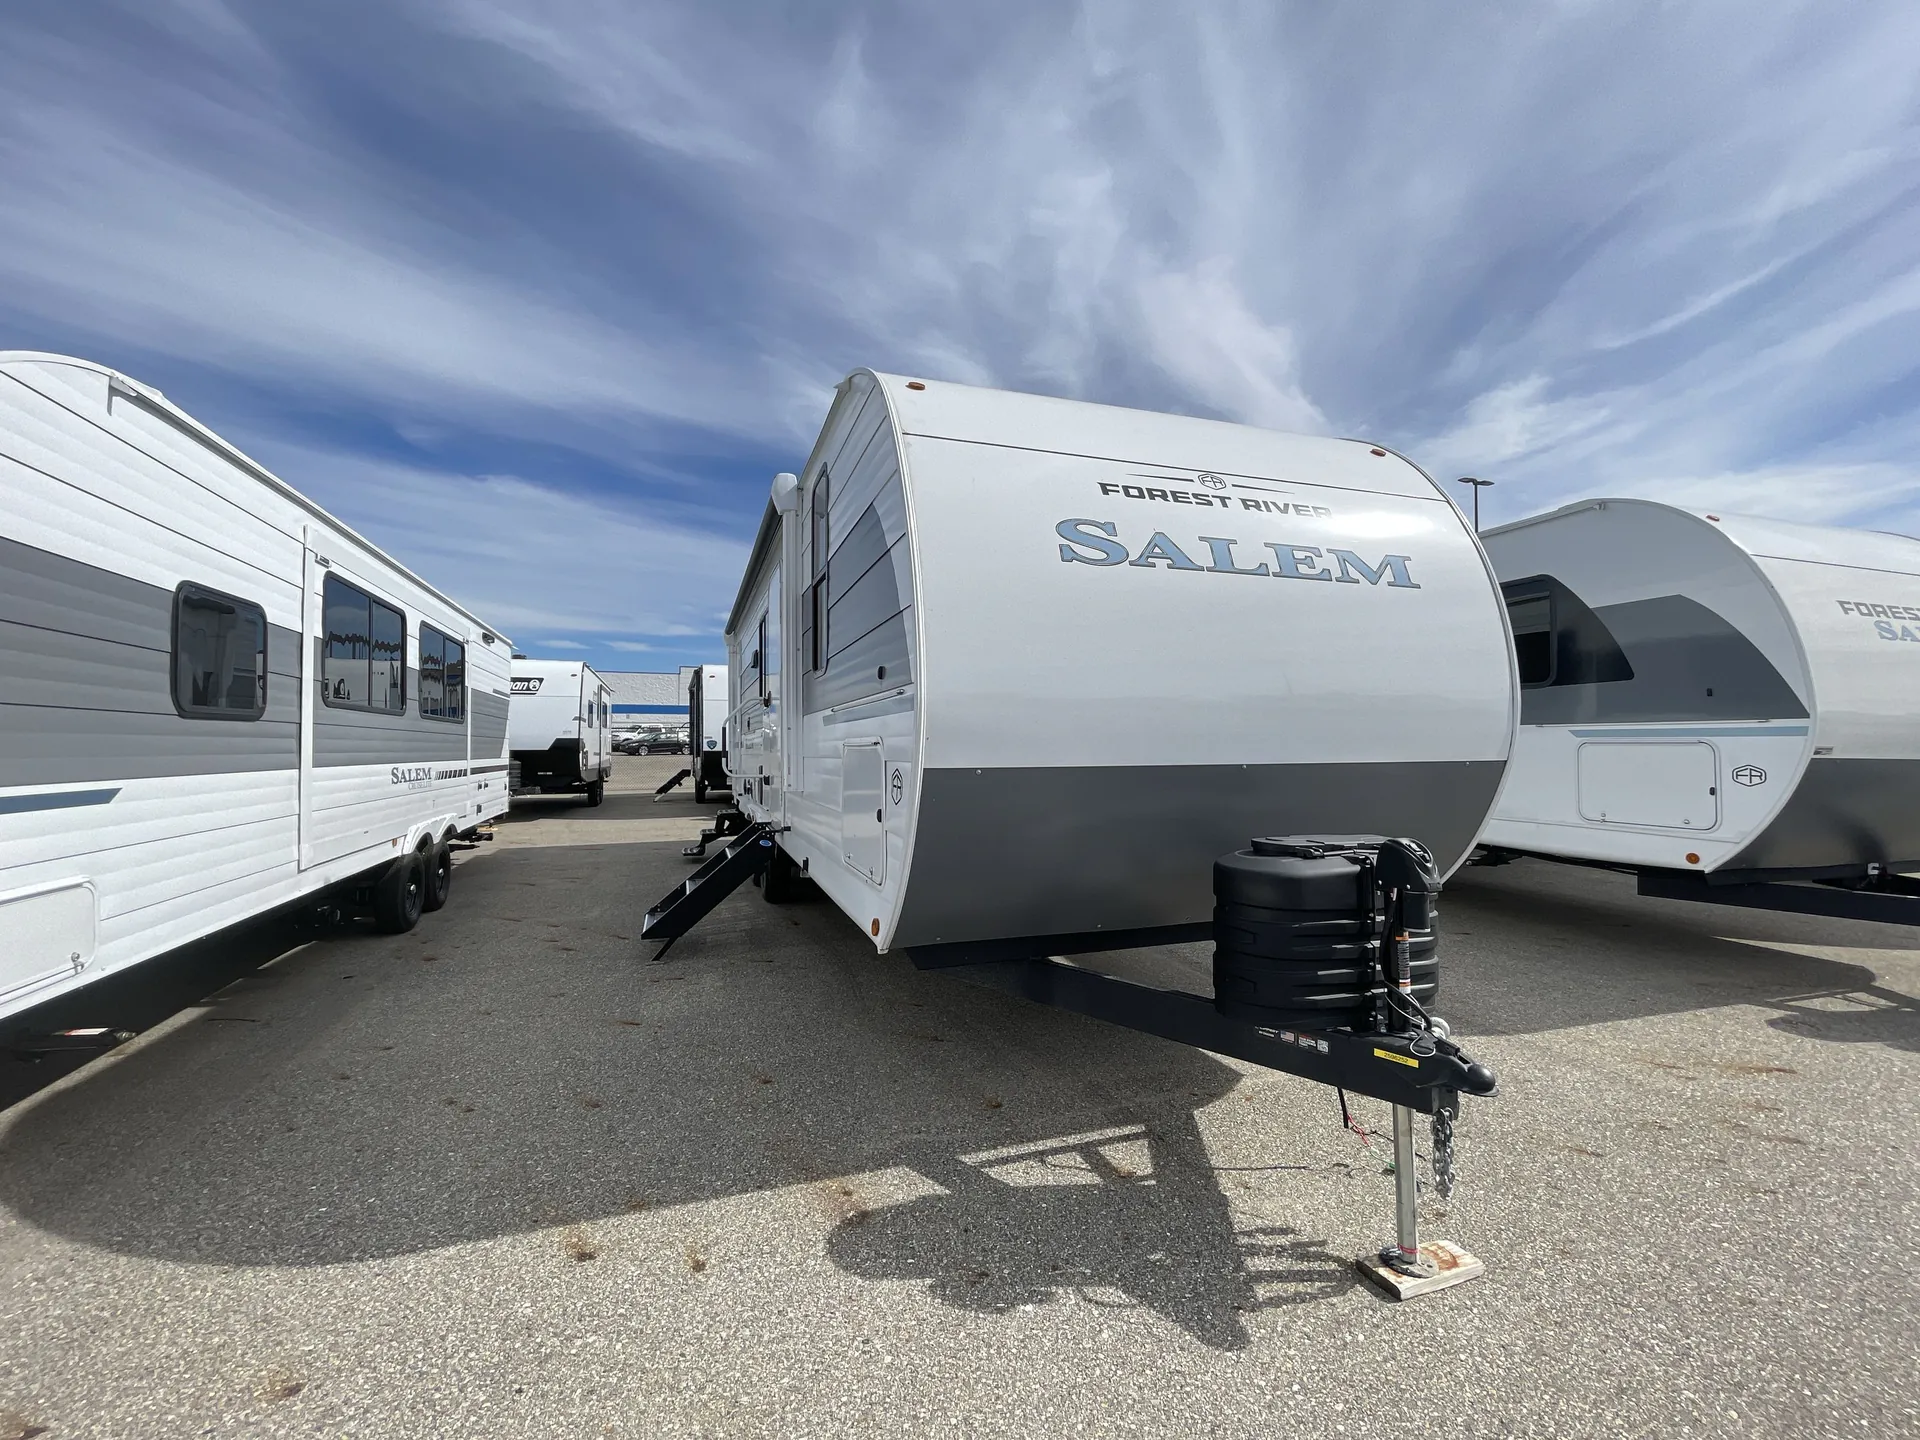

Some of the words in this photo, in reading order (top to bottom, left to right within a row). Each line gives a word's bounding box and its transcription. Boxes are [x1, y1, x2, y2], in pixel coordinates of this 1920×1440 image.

[1097, 481, 1231, 509] FOREST
[1238, 497, 1332, 519] RIVER
[1055, 518, 1421, 589] SALEM
[1874, 620, 1920, 643] SA
[391, 766, 432, 785] SALEM
